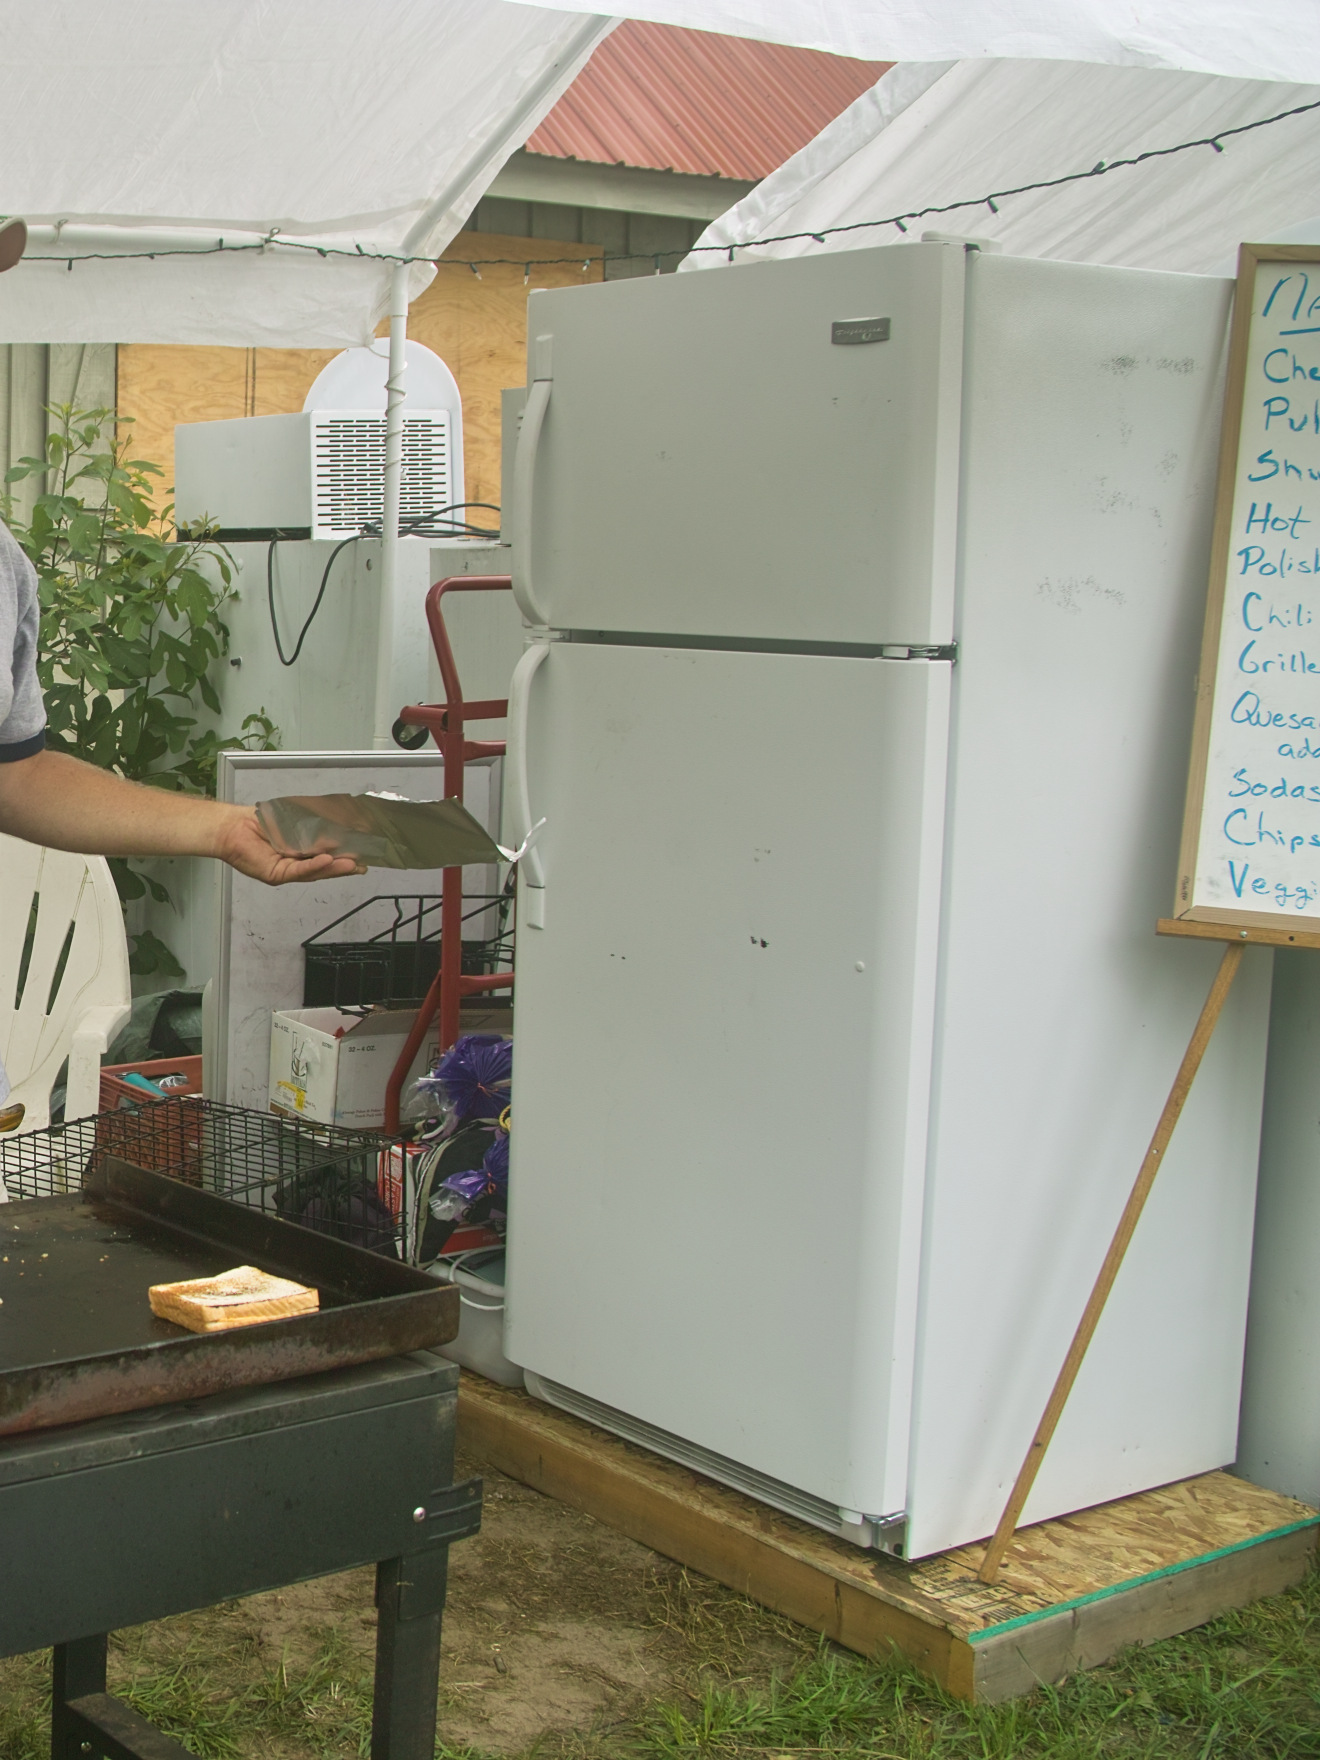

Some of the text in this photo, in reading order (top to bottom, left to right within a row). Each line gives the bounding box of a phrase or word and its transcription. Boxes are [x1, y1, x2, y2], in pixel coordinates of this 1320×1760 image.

[1264, 348, 1320, 383] Che
[1263, 396, 1320, 434] Pul
[1248, 449, 1320, 482] Sh
[1245, 502, 1312, 540] Hot
[1242, 591, 1312, 632] Chili
[1238, 639, 1320, 674] Grille
[1230, 690, 1320, 730] Quesa
[1228, 768, 1320, 802] Sodas
[1224, 808, 1320, 853] Chips
[1228, 860, 1318, 909] Veggi
